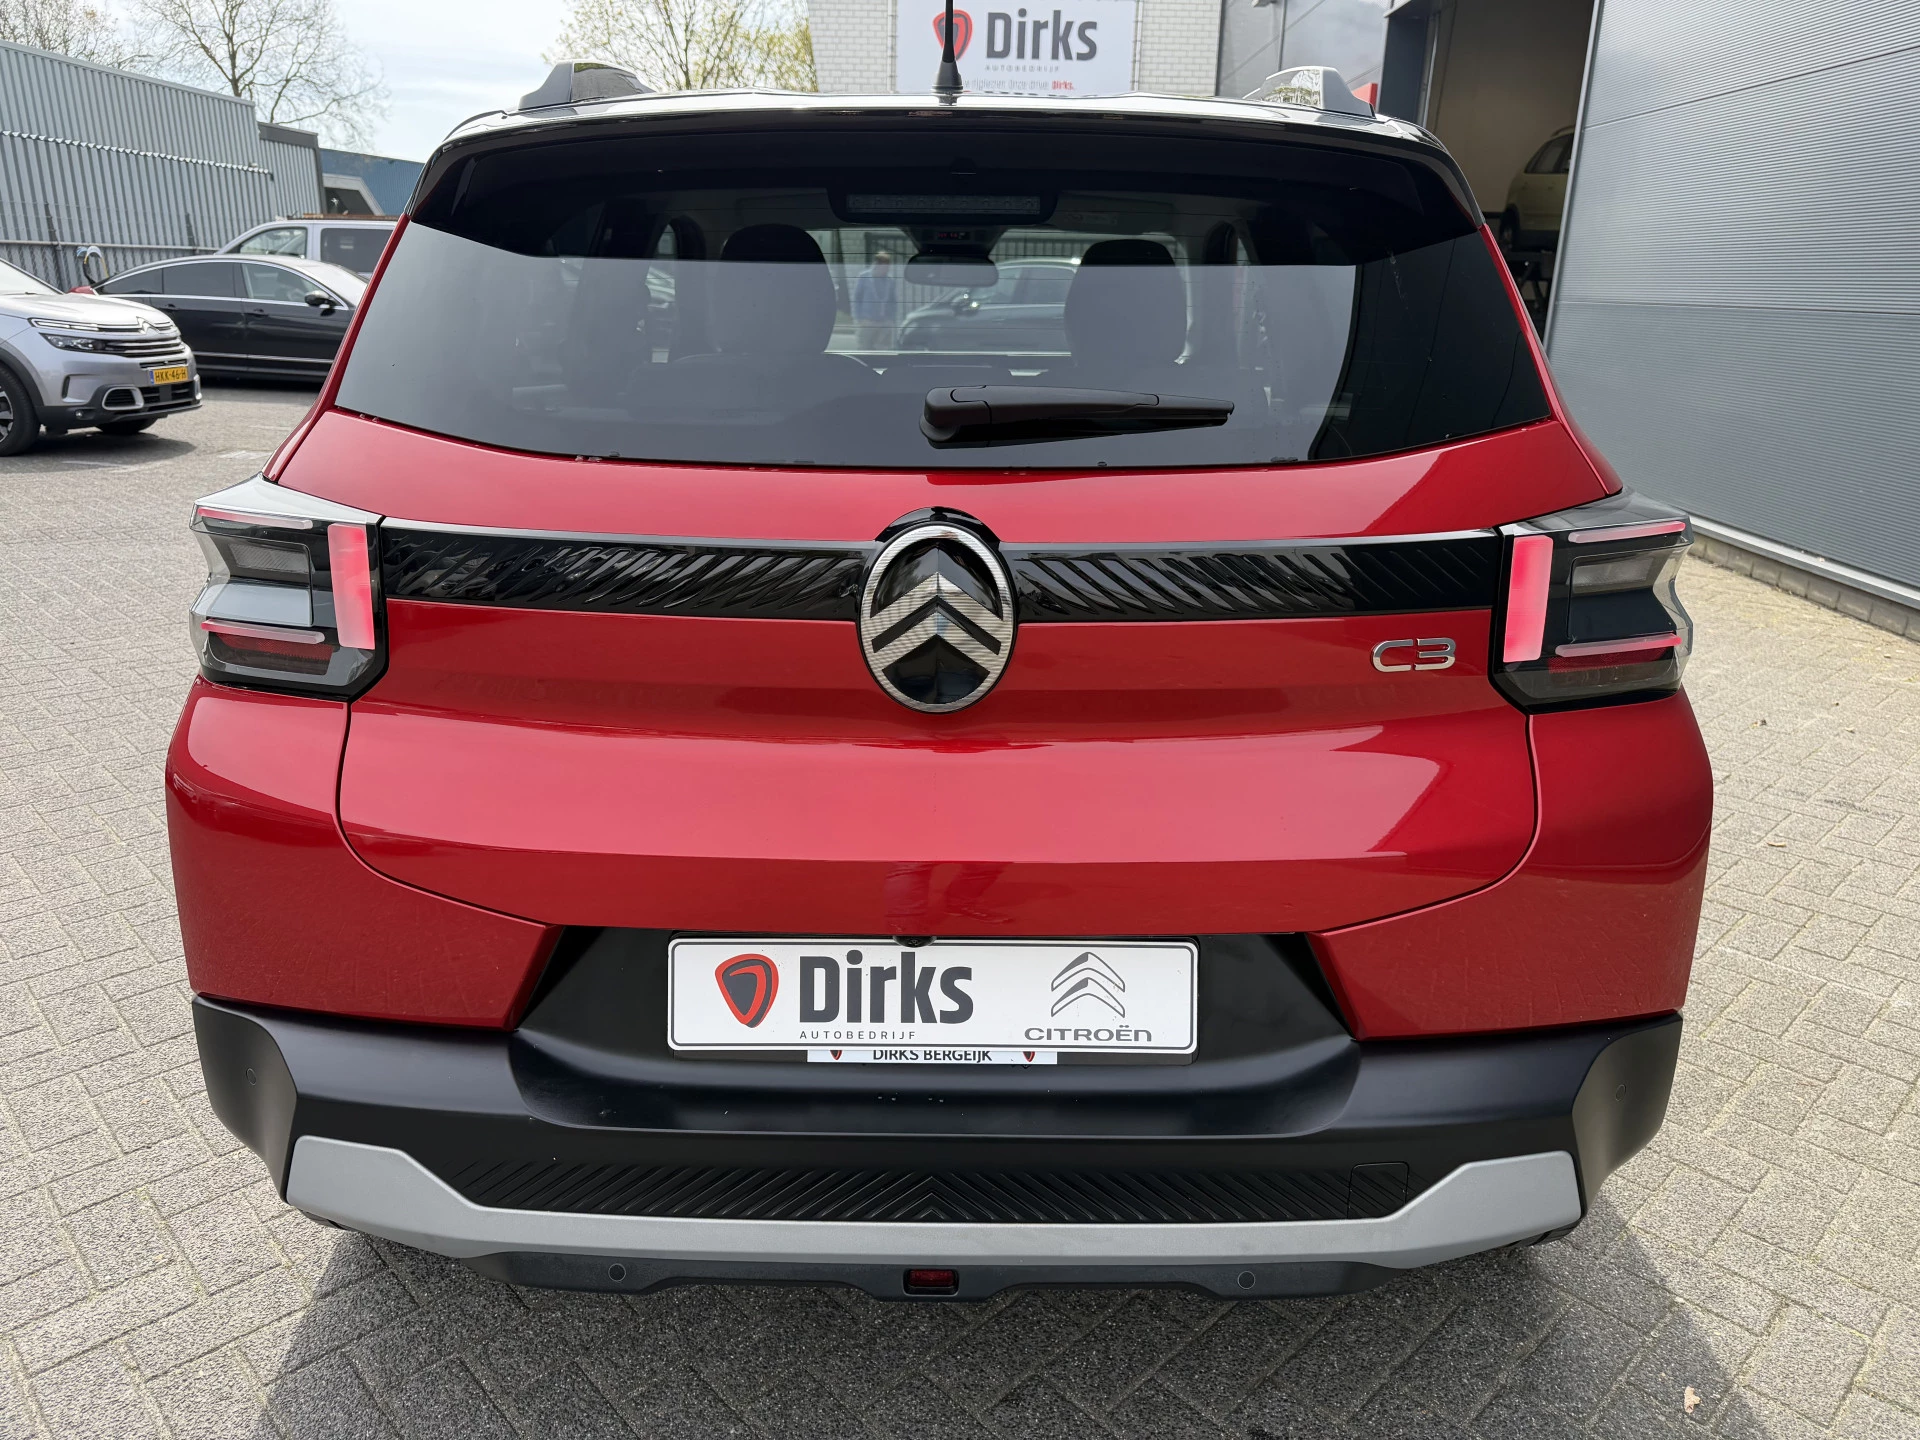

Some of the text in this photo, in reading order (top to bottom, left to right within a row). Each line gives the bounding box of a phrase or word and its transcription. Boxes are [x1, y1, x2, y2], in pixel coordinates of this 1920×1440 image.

[986, 8, 1098, 61] Dirks
[1372, 637, 1456, 672] C3
[799, 949, 974, 1024] Dirks
[799, 1031, 916, 1040] AUTOBEDRIJF
[1024, 1024, 1152, 1042] CITROËN
[872, 1049, 993, 1063] DIRKS BERGEIJK
